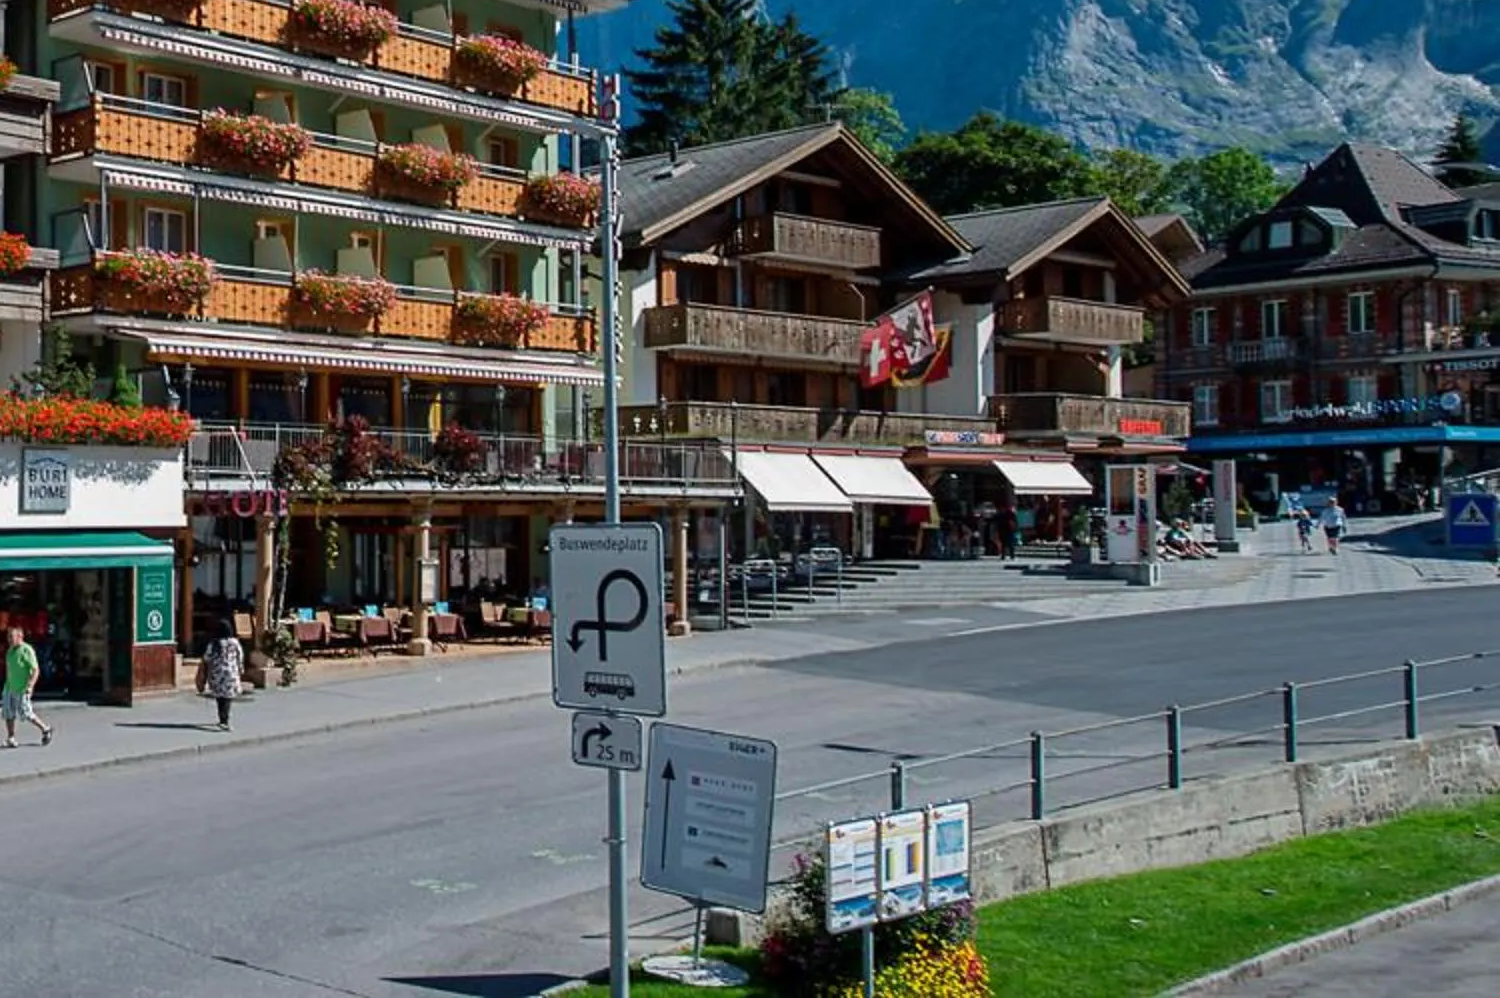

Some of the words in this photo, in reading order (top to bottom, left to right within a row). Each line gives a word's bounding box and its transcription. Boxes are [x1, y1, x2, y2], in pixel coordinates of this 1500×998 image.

[28, 467, 68, 484] BURI
[28, 484, 67, 500] HOME
[559, 536, 649, 554] Buswendeplatz
[596, 743, 615, 761] 25
[619, 750, 635, 764] m
